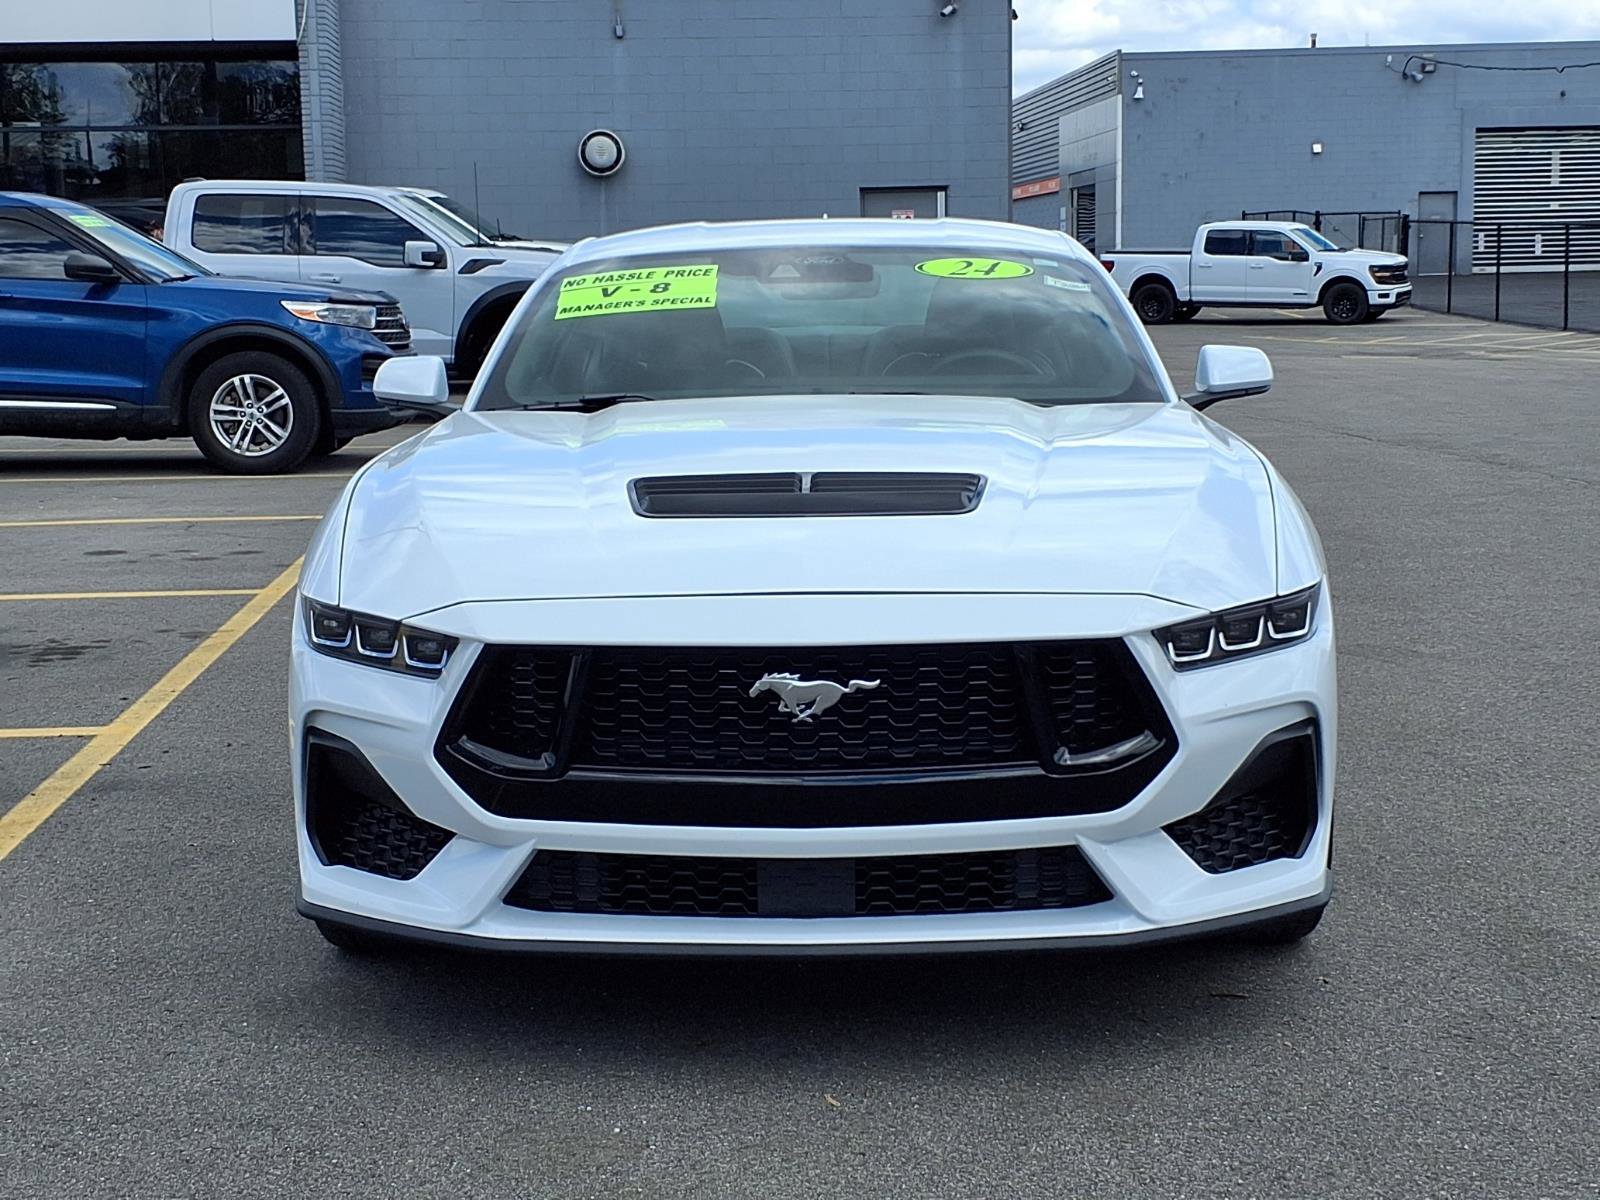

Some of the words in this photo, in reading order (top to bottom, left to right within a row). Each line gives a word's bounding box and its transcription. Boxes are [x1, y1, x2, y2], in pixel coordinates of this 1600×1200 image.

[948, 260, 1001, 276] 24
[563, 278, 587, 289] NO
[592, 271, 657, 284] HASSLE
[663, 268, 714, 279] PRICE
[559, 300, 646, 315] MANAGER'S
[650, 297, 712, 306] SPECIAL
